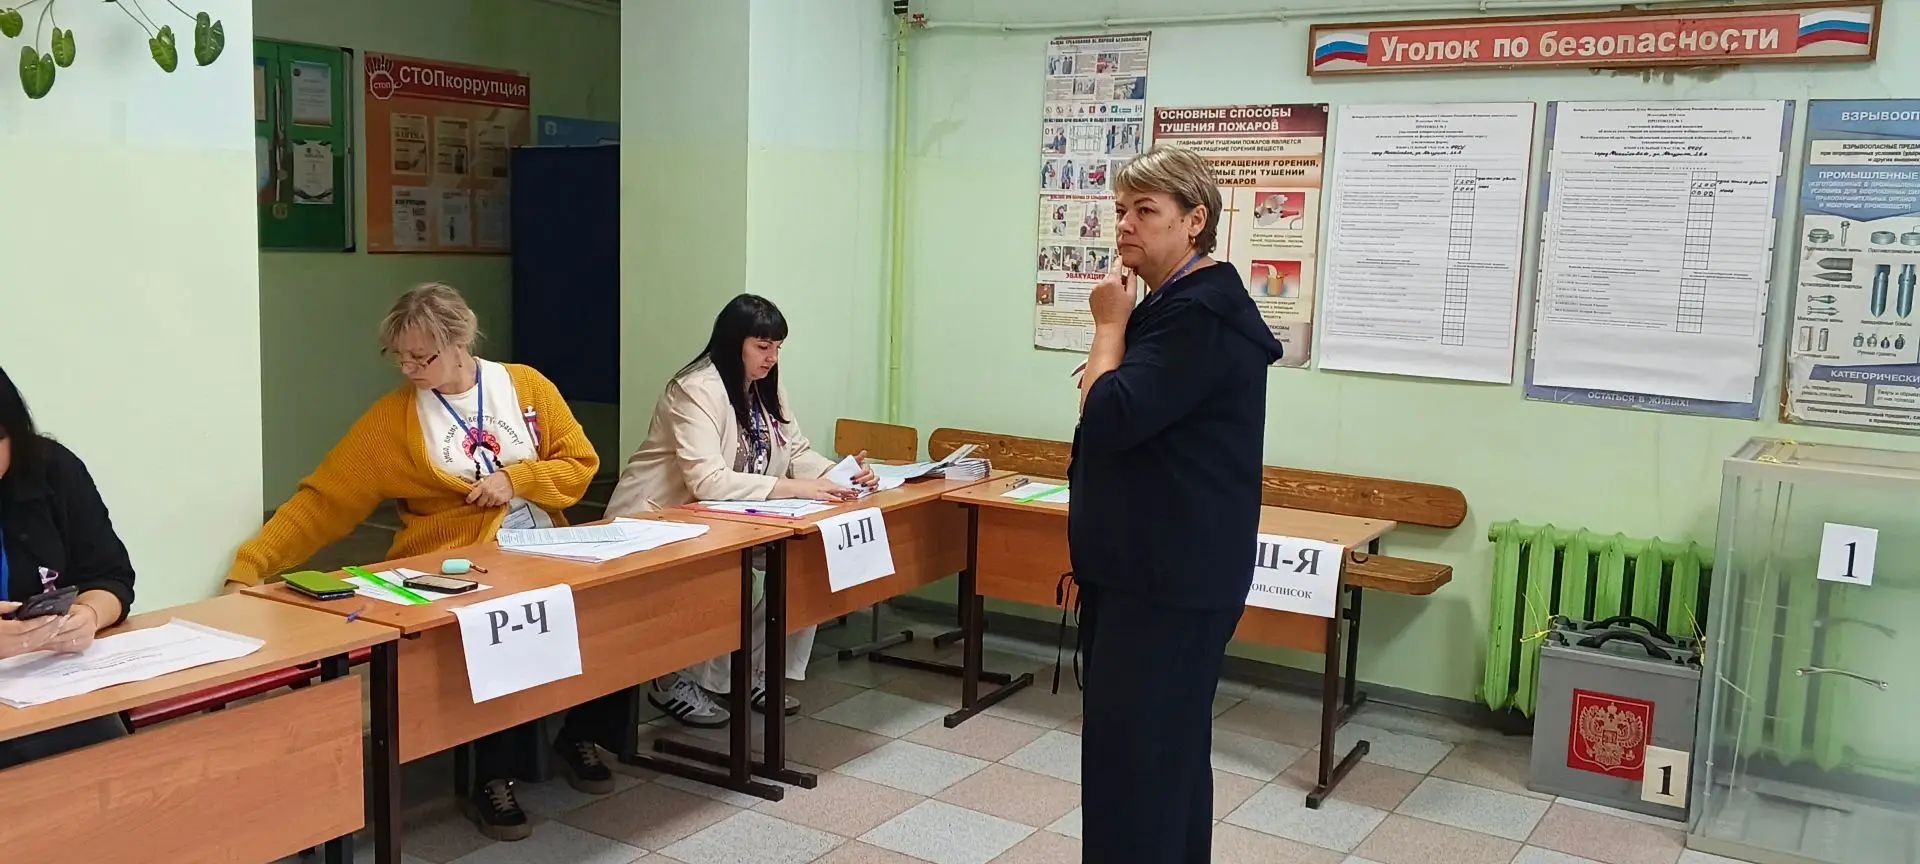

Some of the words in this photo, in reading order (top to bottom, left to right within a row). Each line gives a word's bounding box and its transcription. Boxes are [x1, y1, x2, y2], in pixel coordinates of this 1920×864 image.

[1380, 36, 1480, 63] Уголок
[1493, 37, 1530, 61] по
[1538, 25, 1780, 57] безопасности
[400, 65, 526, 97] СТОПкоррупция
[1160, 109, 1227, 120] ОСНОВНЫЕ
[1229, 107, 1292, 119] СПОСОБЫ
[1159, 123, 1215, 133] ТУШЕНИЯ
[1218, 121, 1279, 132] ПОЖАРОВ
[1261, 168, 1305, 176] ТУШЕНИИ
[1272, 159, 1319, 168] ГОРЕНИЯ,
[1818, 171, 1920, 180] ПРОМЫШЛЕННЫЕ
[1830, 369, 1920, 383] КАТЕГОРИЧЕСКИ
[1587, 391, 1636, 403] ОСТАТЬСЯ
[1648, 397, 1690, 408] ЖИВЫХ!
[837, 516, 876, 551] Л-П
[1841, 541, 1859, 579] 1
[1249, 582, 1313, 600] оп.список
[484, 599, 552, 646] Р-Ч
[1655, 764, 1675, 797] 1
